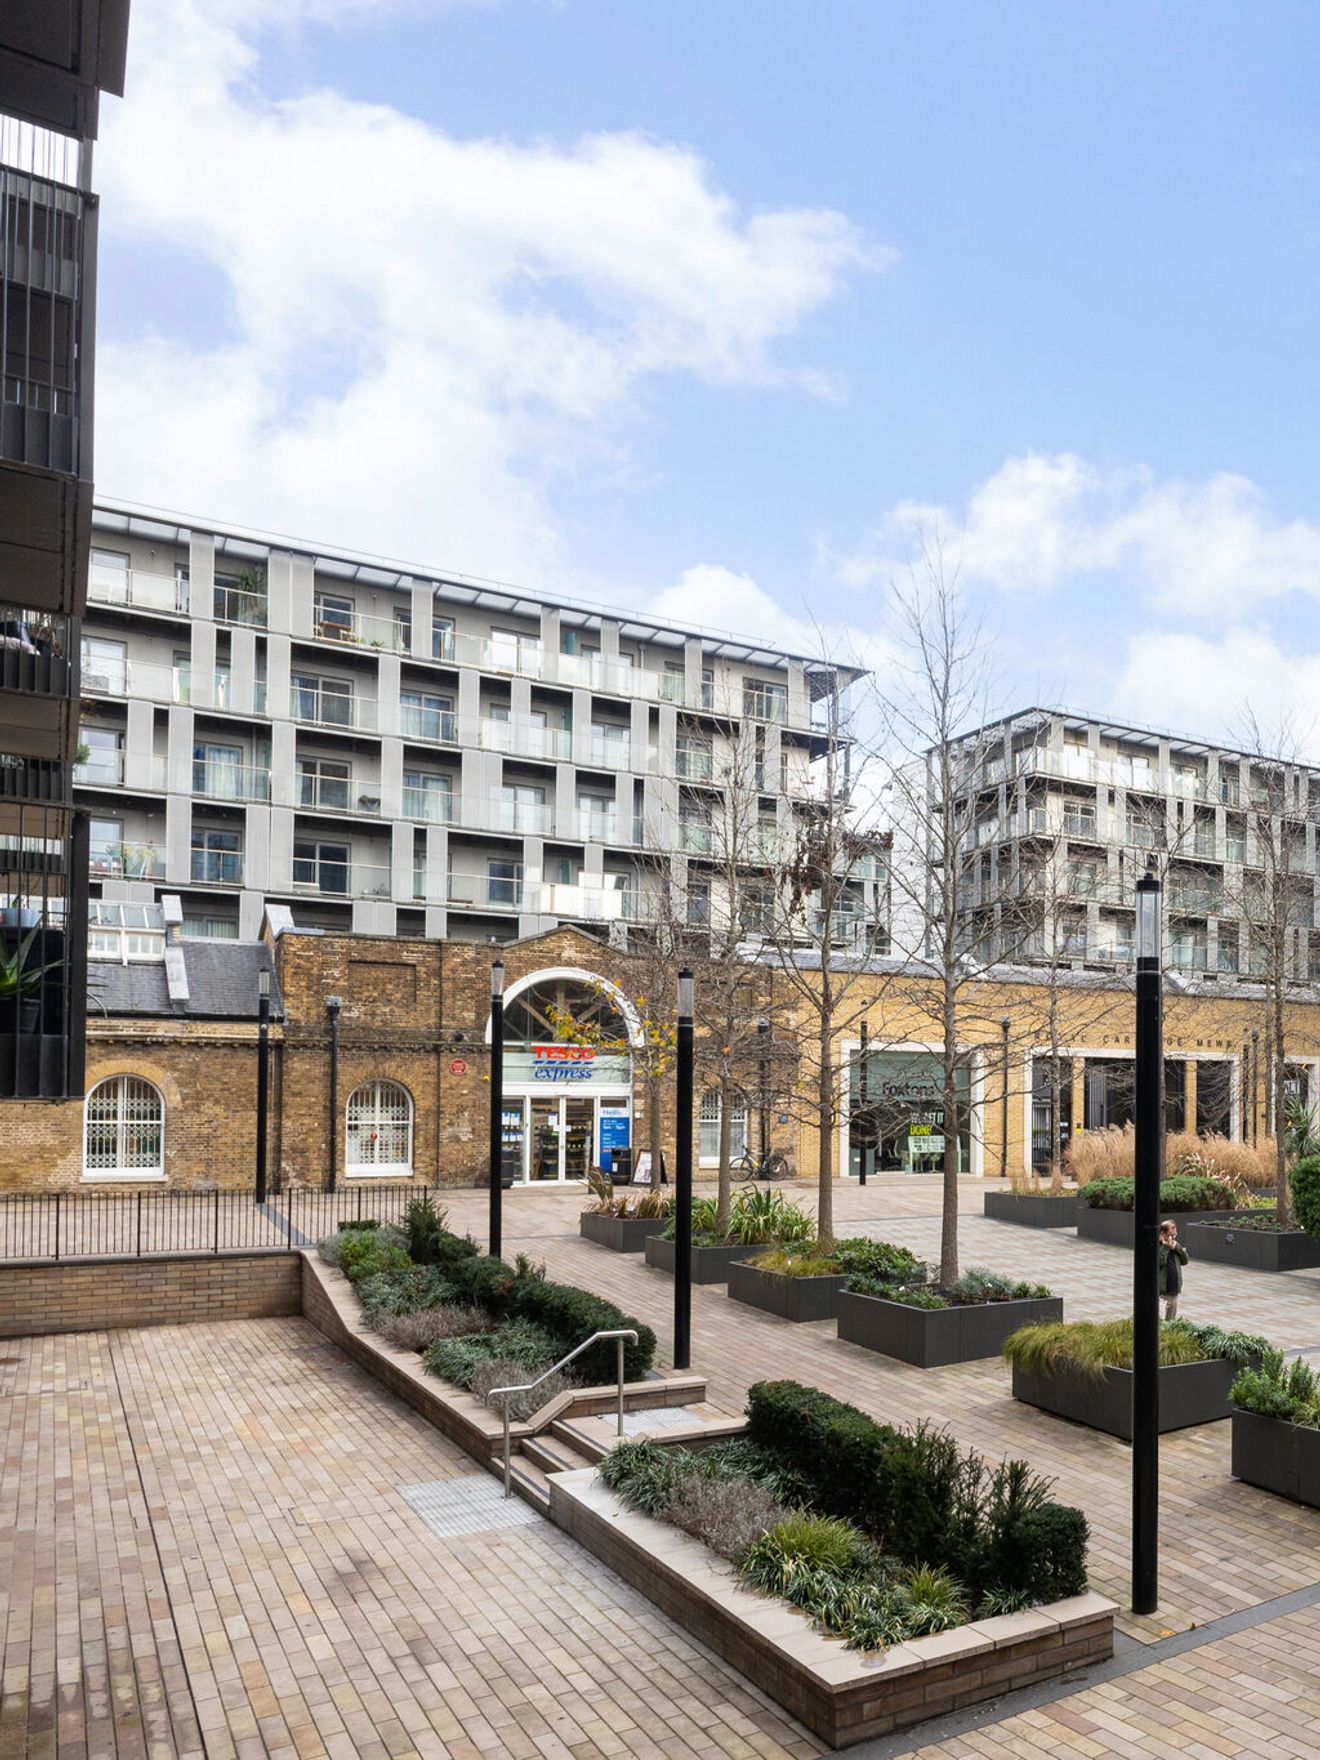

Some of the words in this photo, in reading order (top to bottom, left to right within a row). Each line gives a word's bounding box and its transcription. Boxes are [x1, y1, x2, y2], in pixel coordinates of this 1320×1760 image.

[1103, 1034, 1186, 1048] CARGE
[532, 1046, 596, 1060] TESCO
[534, 1066, 593, 1082] express
[910, 1124, 931, 1136] DONE
